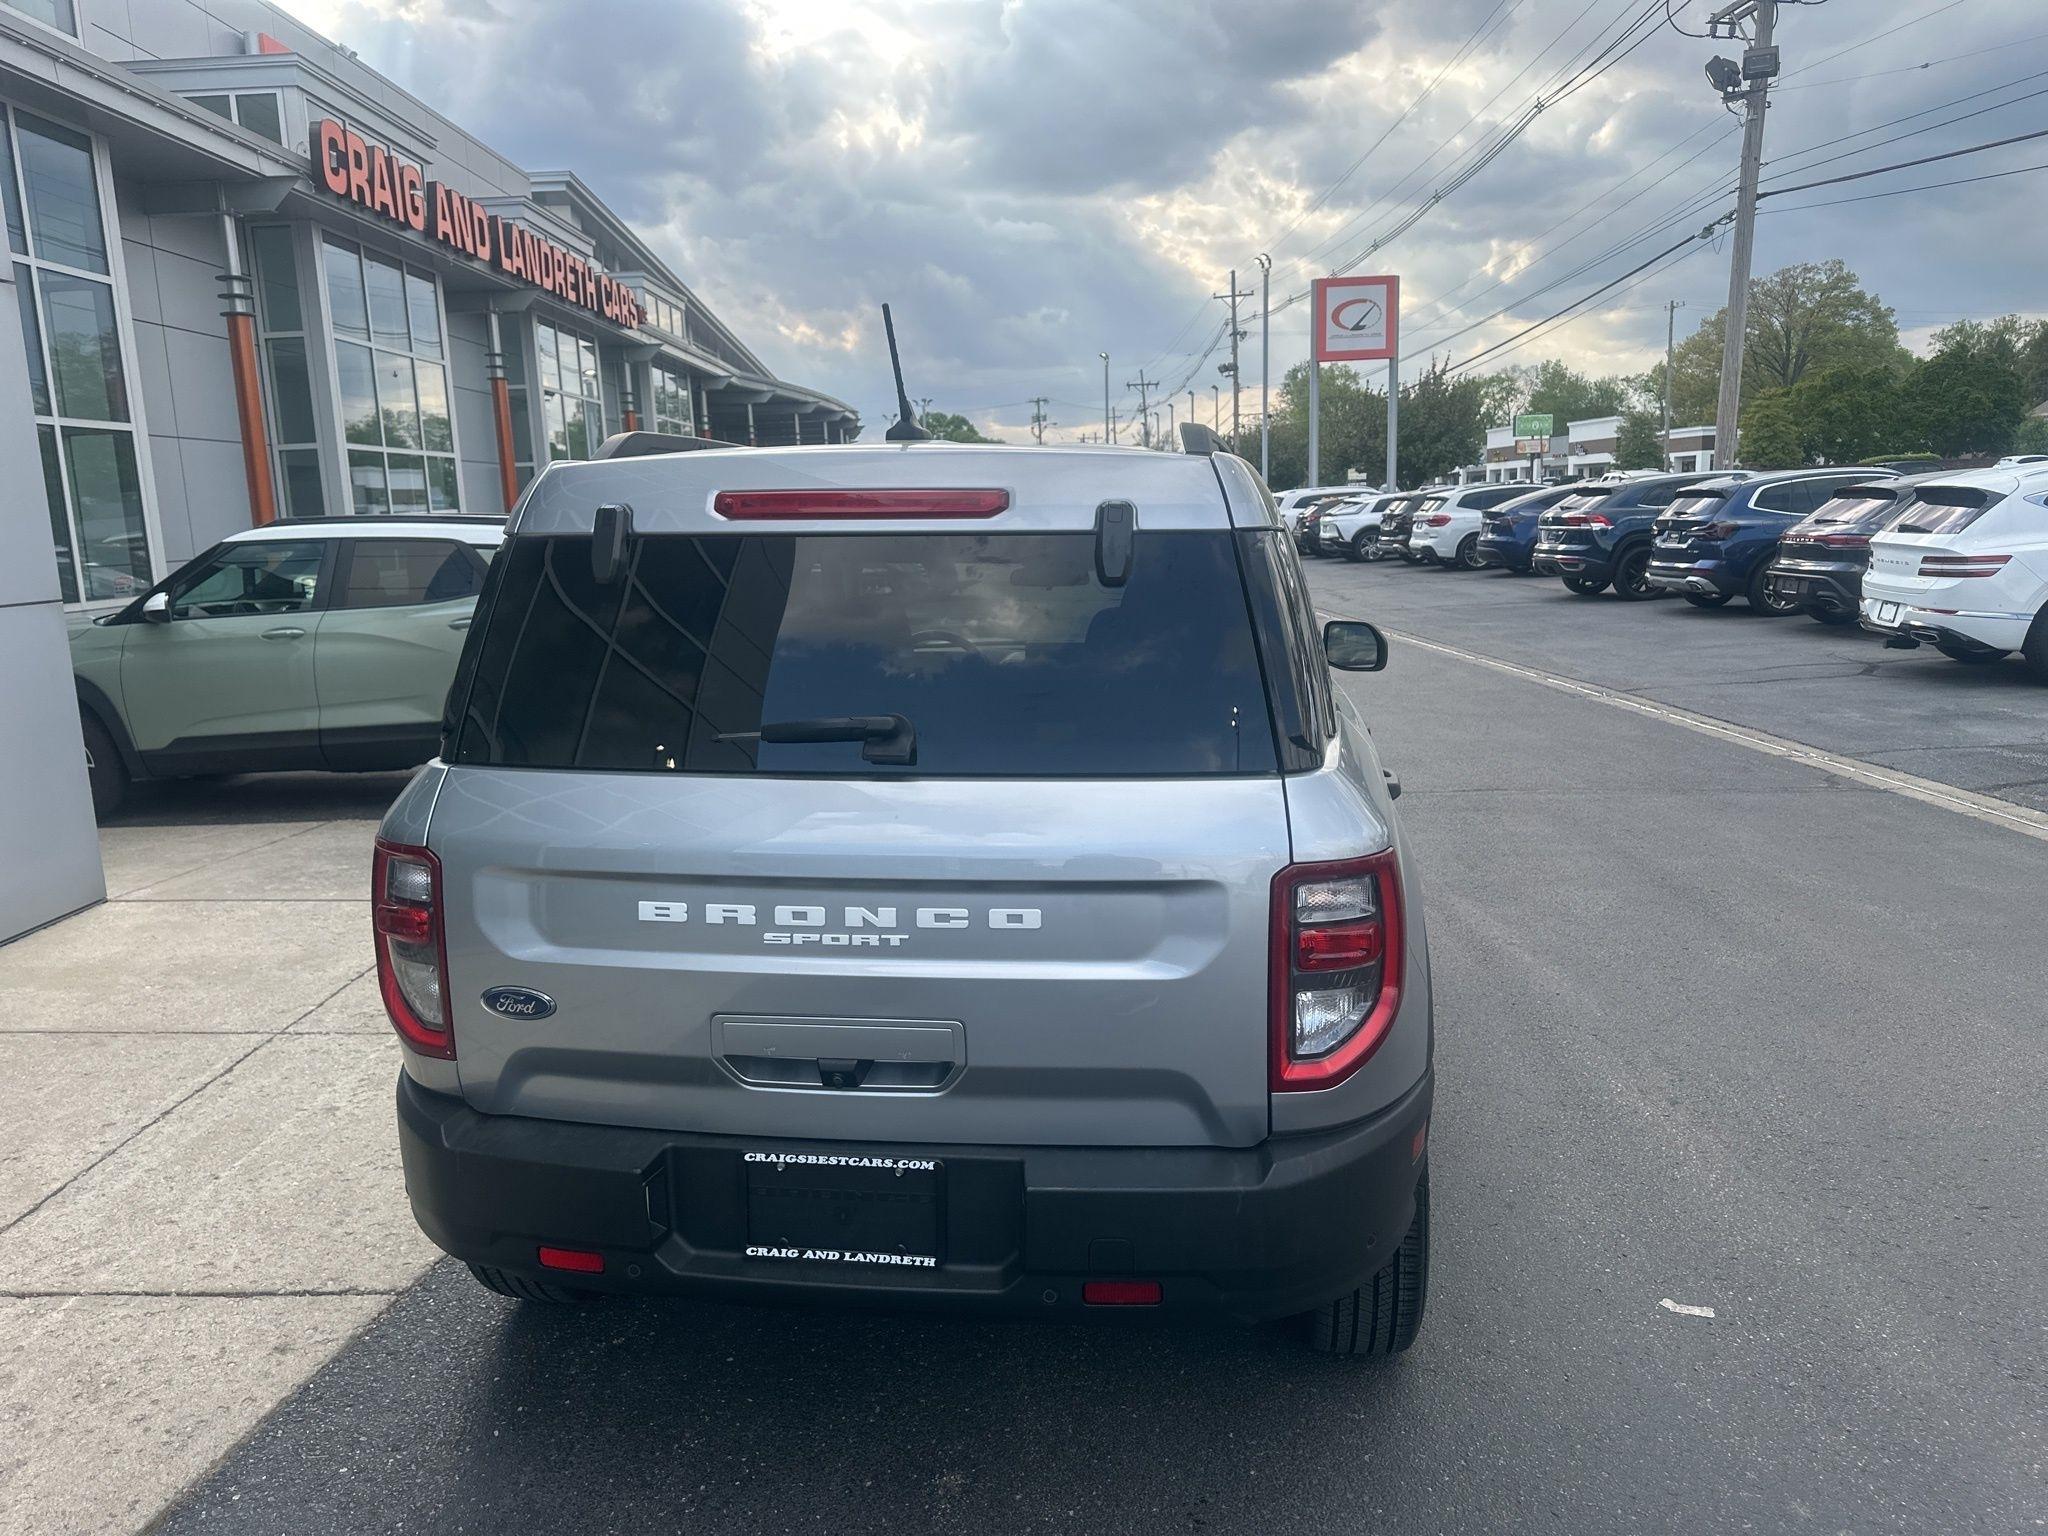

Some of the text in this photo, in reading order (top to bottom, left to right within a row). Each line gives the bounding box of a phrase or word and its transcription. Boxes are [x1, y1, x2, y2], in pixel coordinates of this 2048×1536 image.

[319, 118, 639, 330] CRAIG AND LANDRETH CARS
[637, 900, 1043, 930] BRONCO
[762, 932, 910, 947] SPORT
[496, 993, 537, 1014] Ford
[743, 1152, 936, 1171] CRAIGSBESTCARS.COM
[745, 1246, 937, 1267] CRAIG AND LANDRETH
